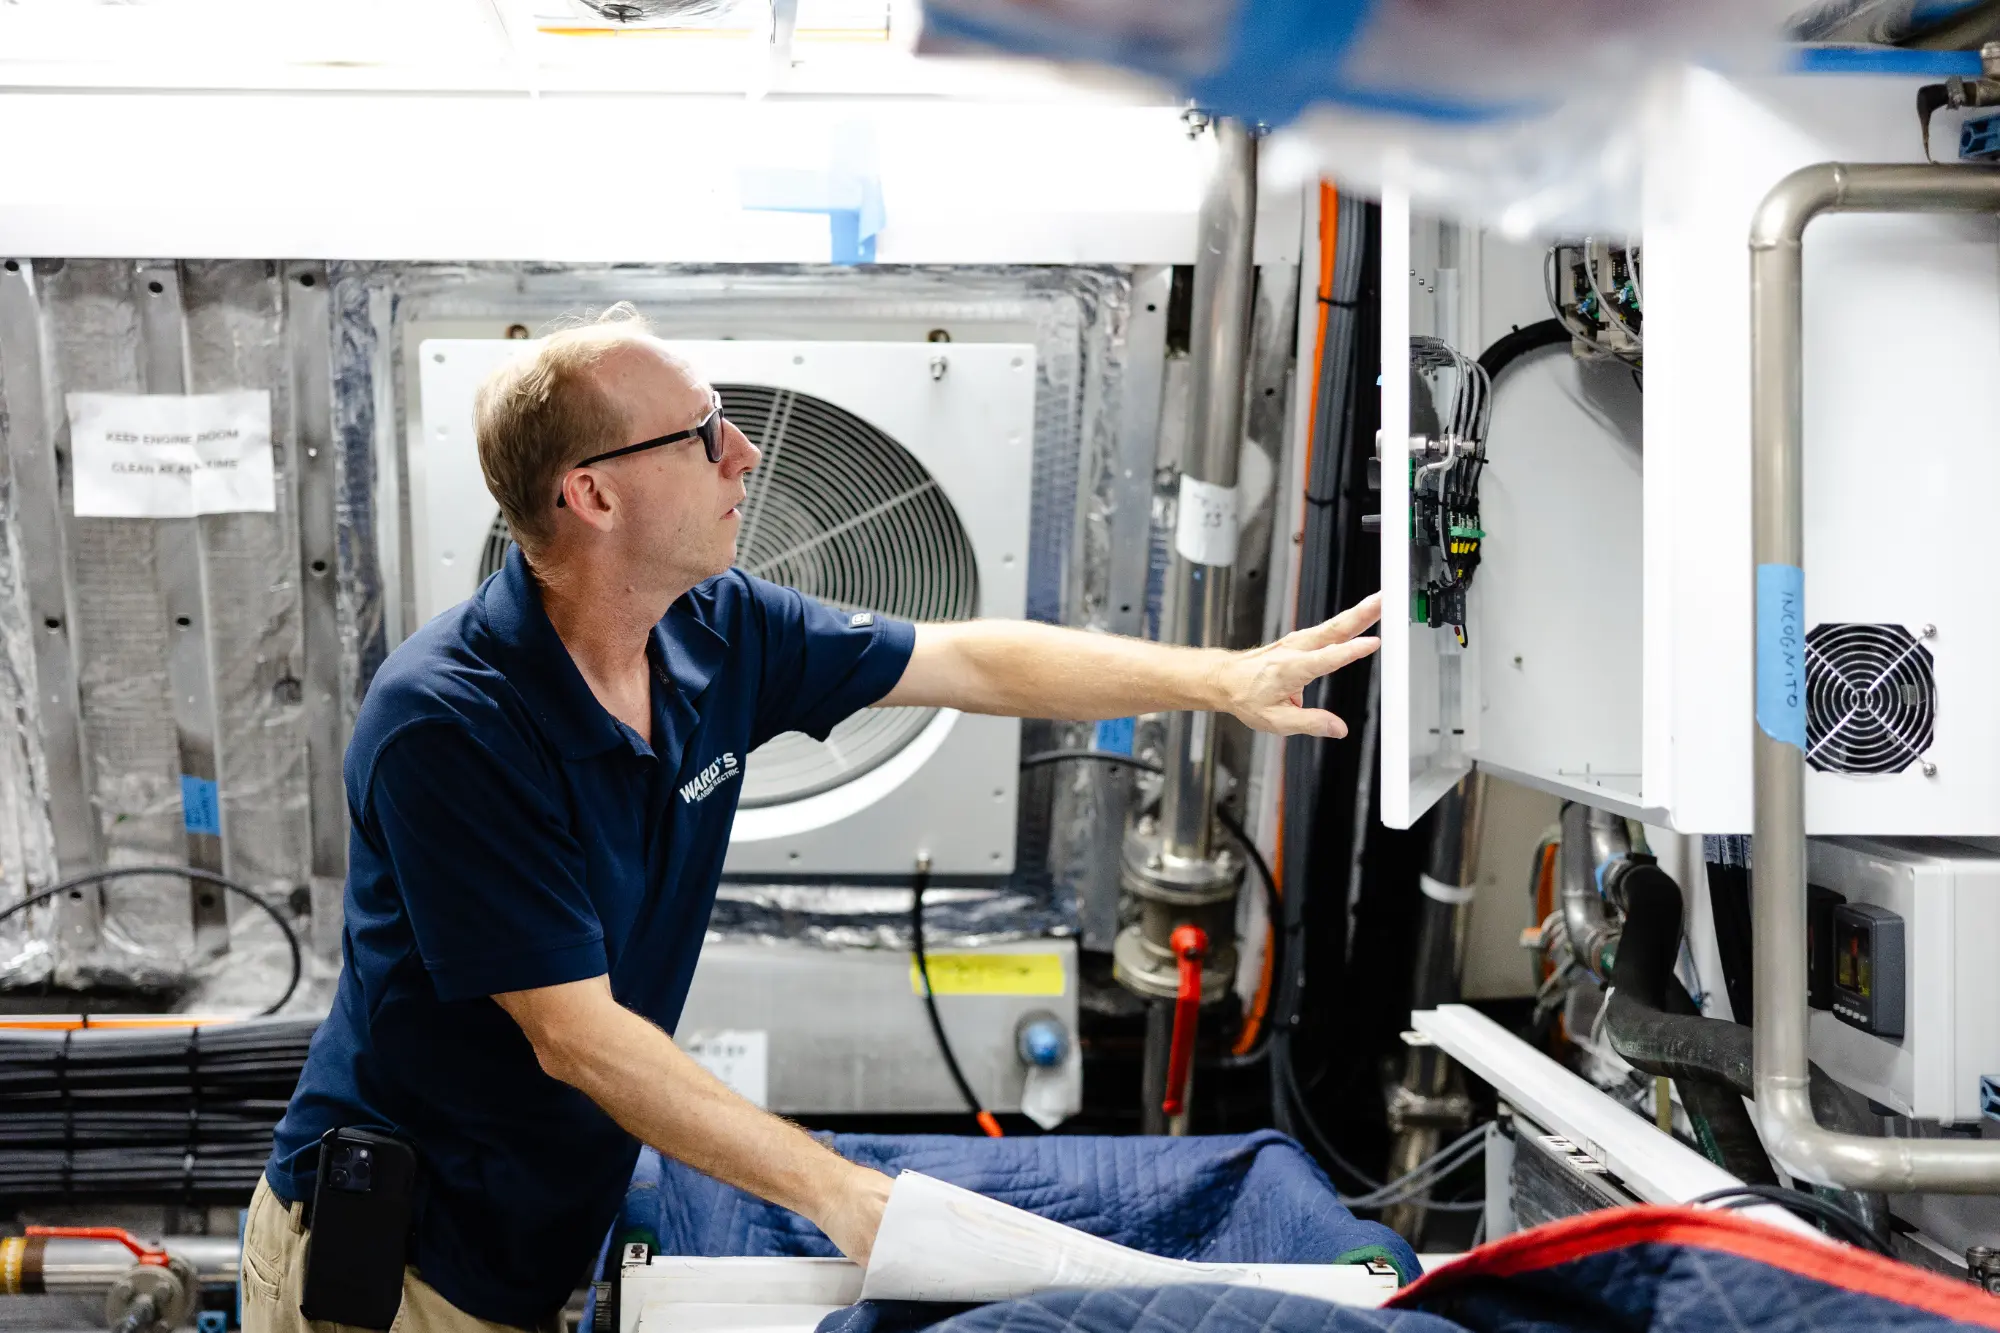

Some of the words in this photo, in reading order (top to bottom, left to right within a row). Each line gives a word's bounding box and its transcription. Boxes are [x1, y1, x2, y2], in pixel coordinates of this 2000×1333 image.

[105, 430, 139, 443] KEEP
[143, 432, 193, 446] ENGINE
[196, 428, 240, 444] ROOM
[111, 461, 154, 475] CLEAN
[1779, 591, 1799, 708] INCOGNITO
